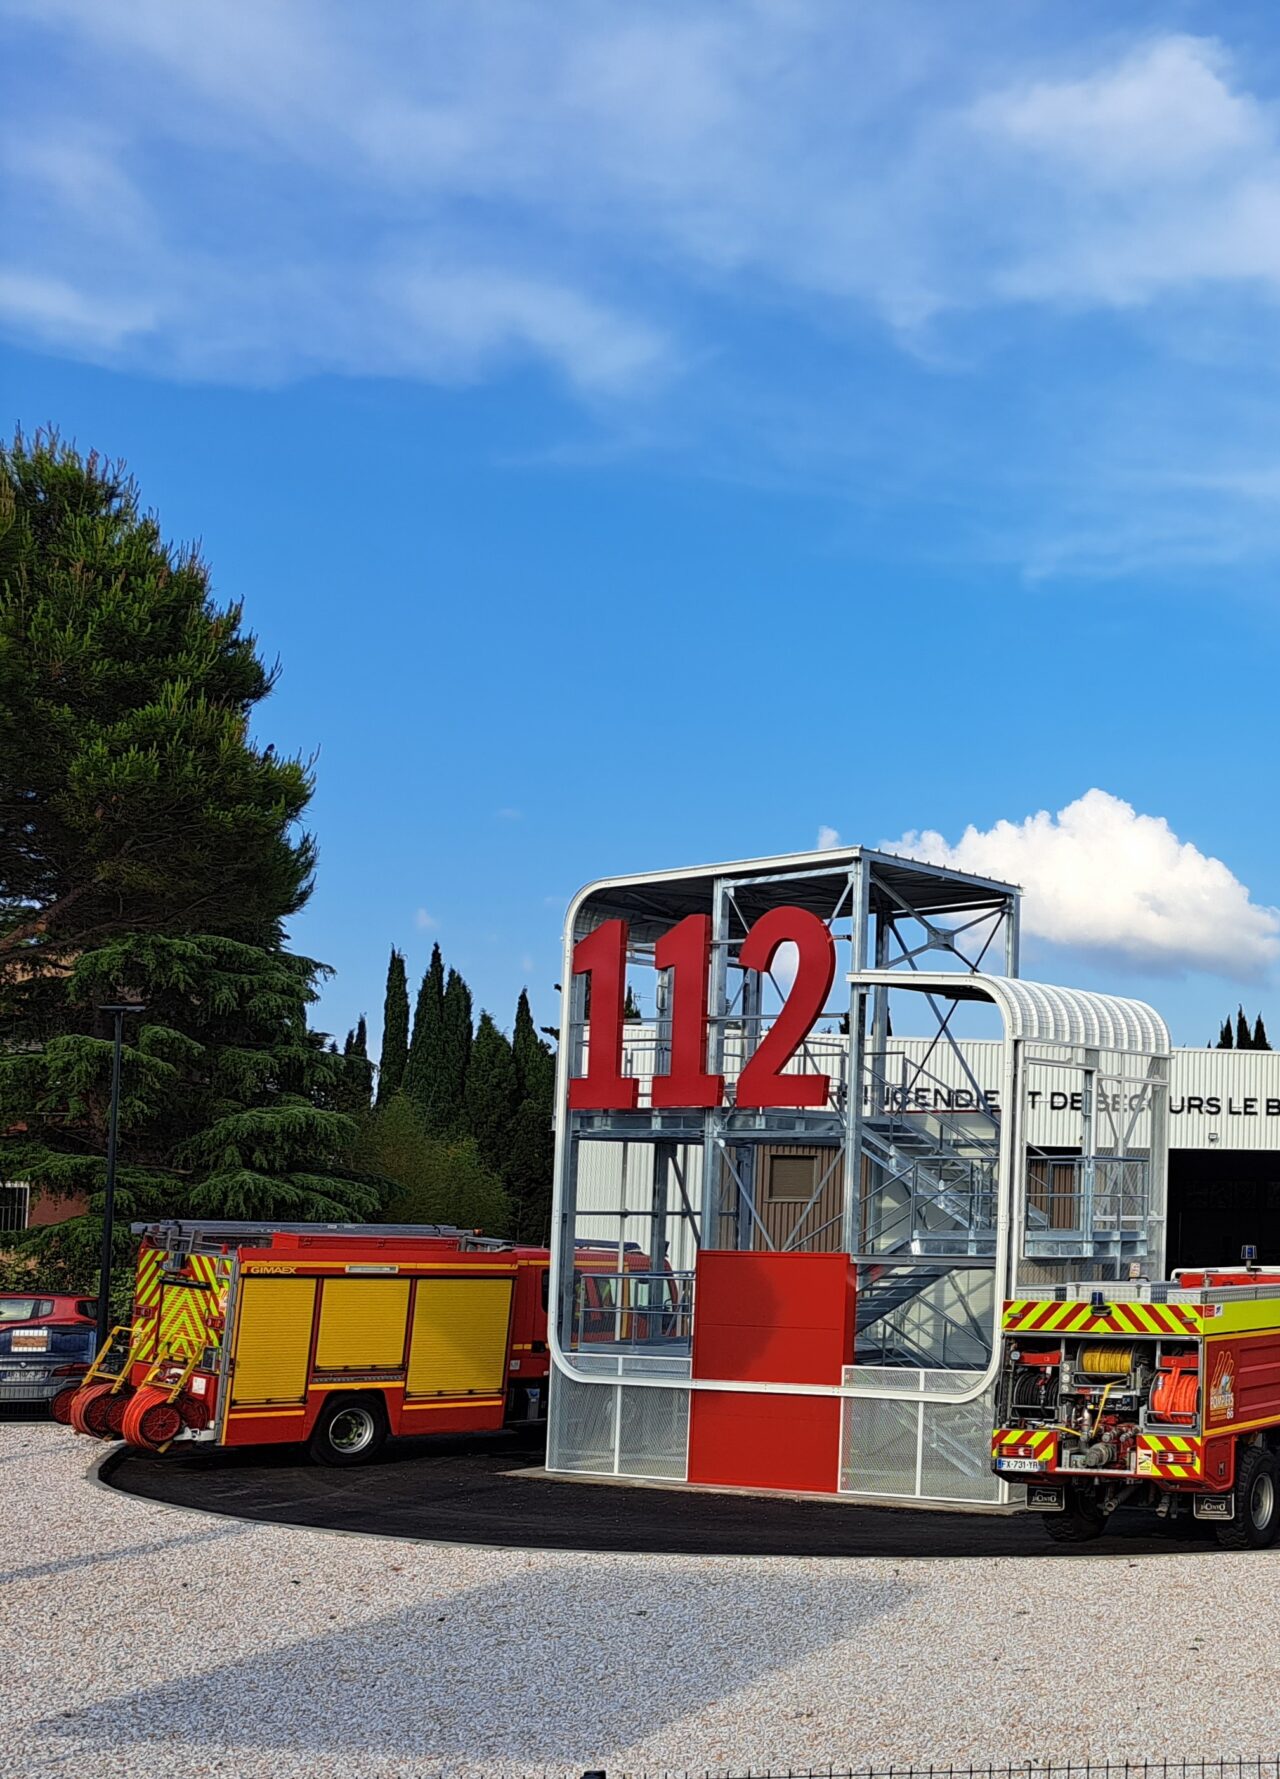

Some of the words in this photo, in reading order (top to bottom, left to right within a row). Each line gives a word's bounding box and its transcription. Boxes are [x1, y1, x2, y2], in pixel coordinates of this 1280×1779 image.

[568, 905, 836, 1110] 112
[1050, 1092, 1084, 1112] DE
[1096, 1093, 1221, 1117] SECURS
[1228, 1097, 1258, 1117] LE
[250, 1266, 297, 1275] GIMAEX
